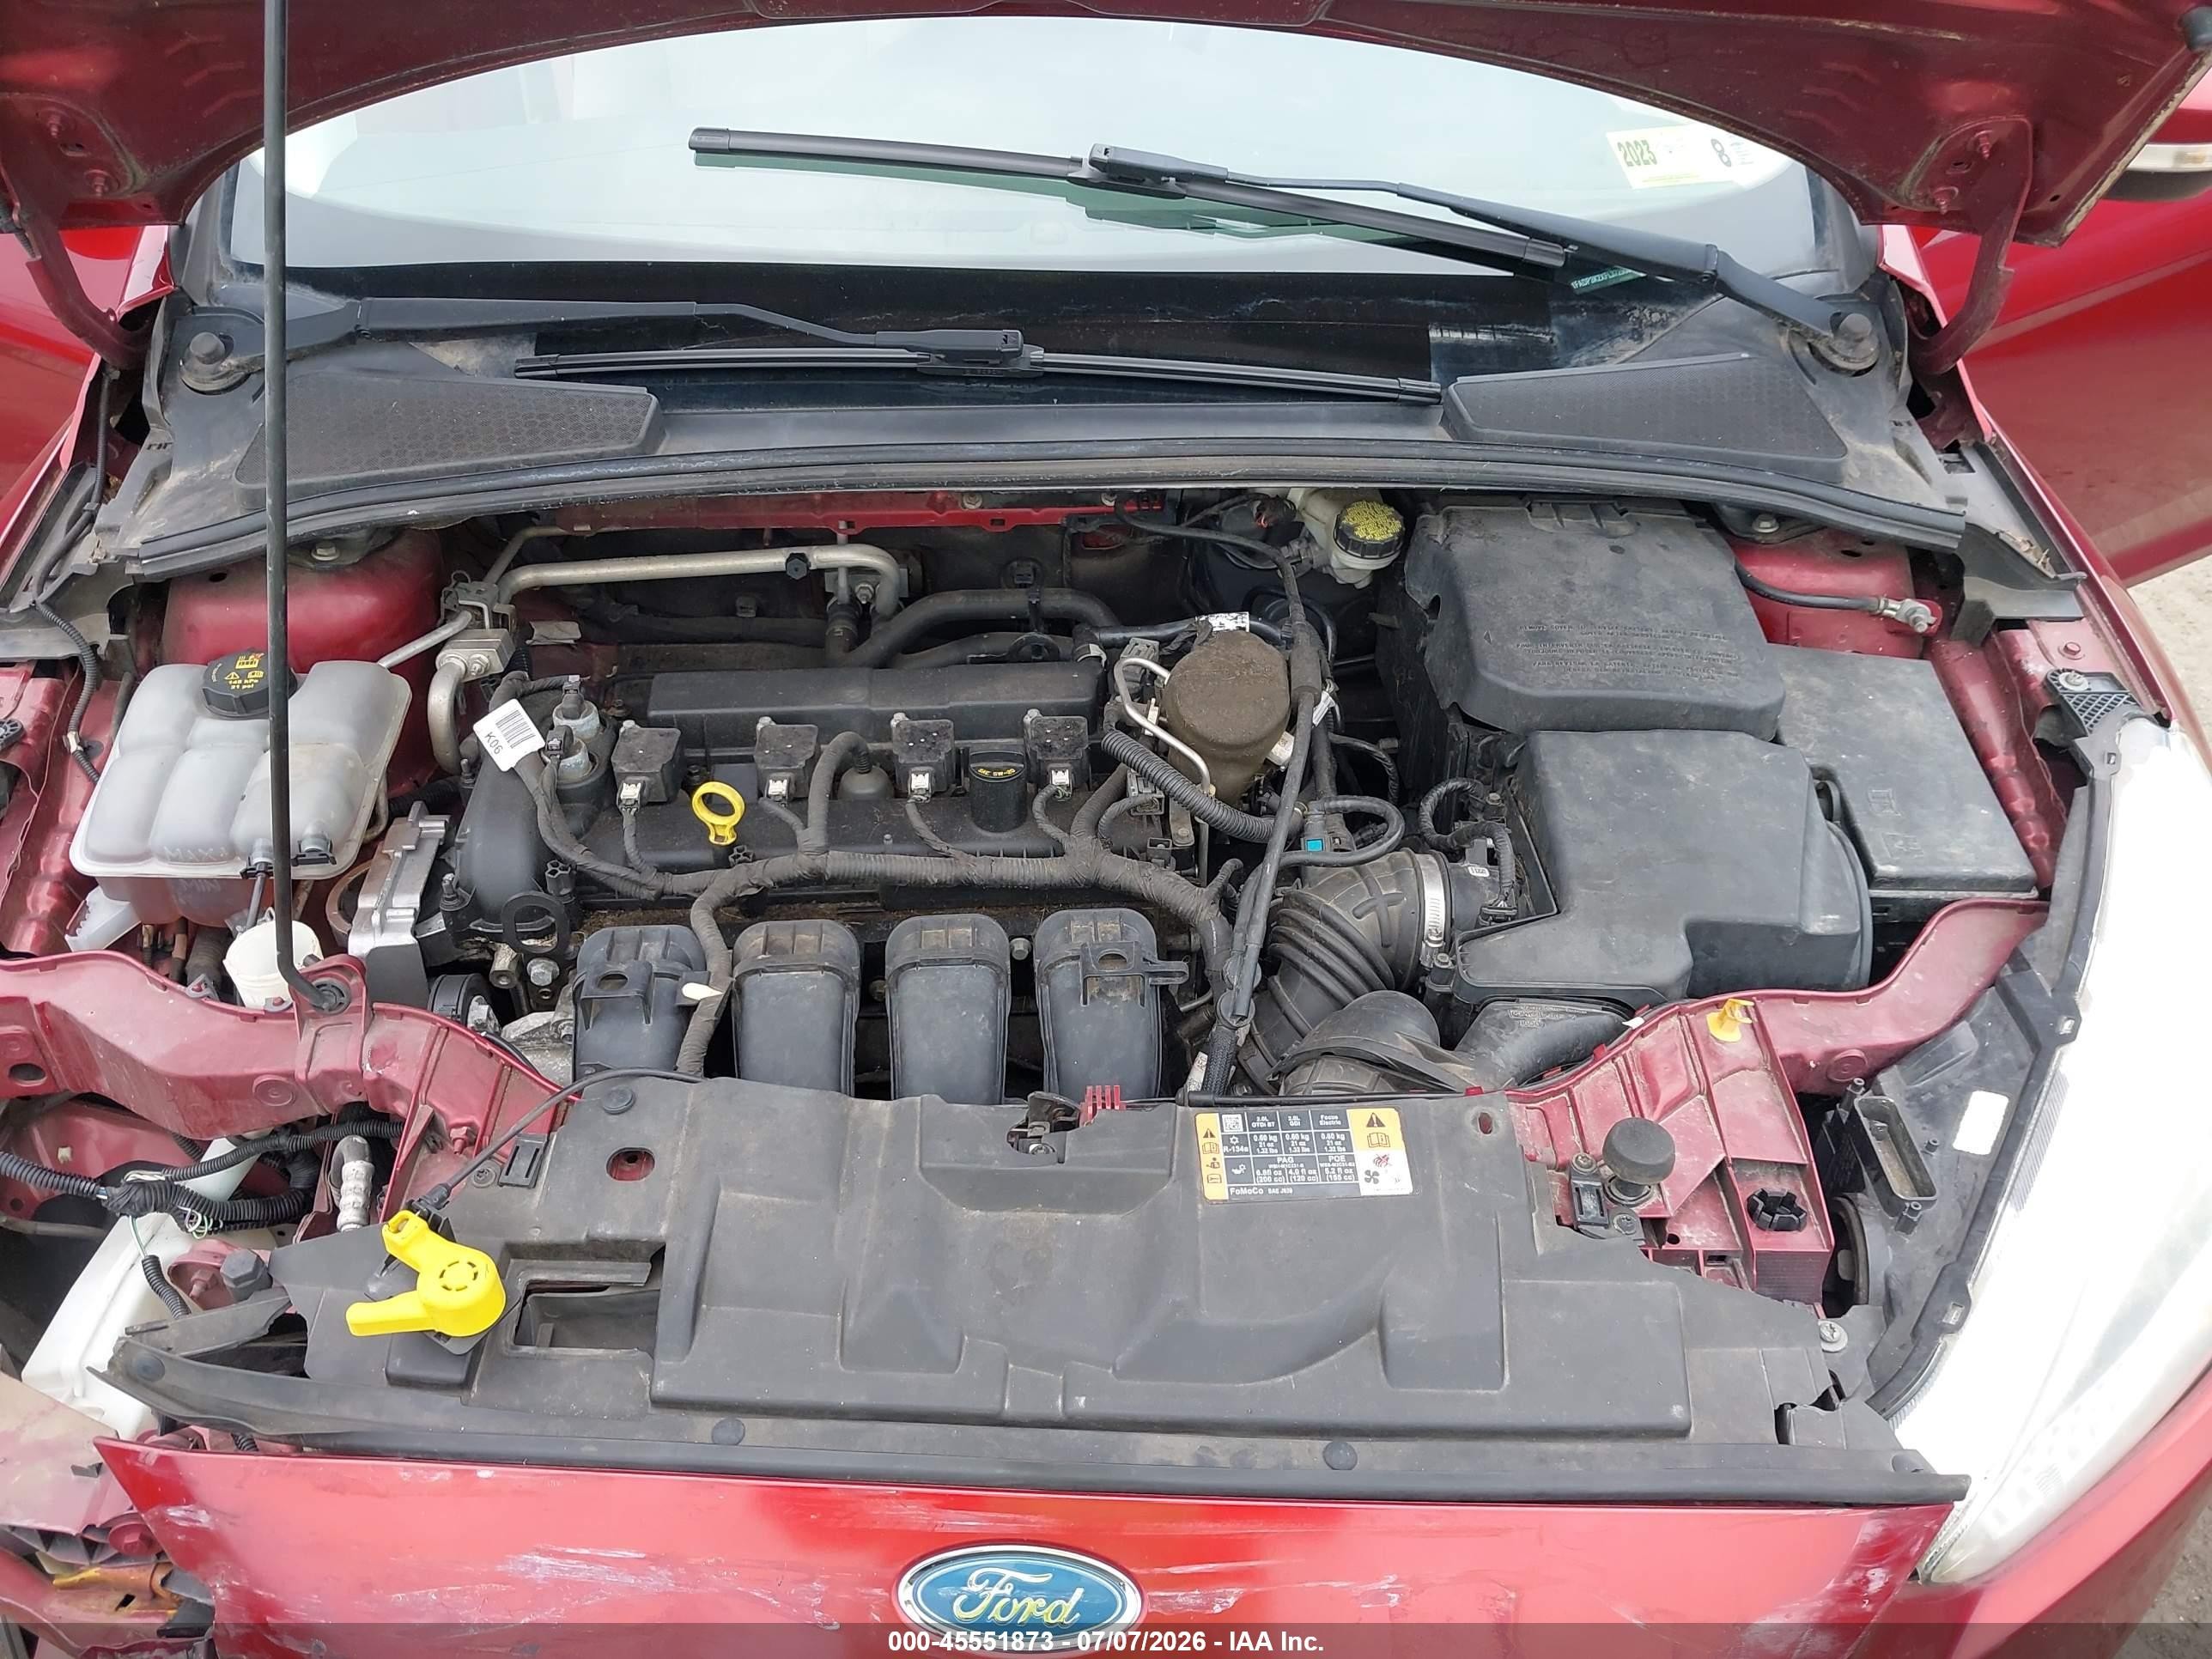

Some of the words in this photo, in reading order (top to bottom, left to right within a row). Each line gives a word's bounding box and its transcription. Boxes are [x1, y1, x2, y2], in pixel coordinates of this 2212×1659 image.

[1617, 139, 1657, 167] 2023
[1711, 139, 1732, 167] 8
[484, 731, 503, 754] K06
[1229, 1187, 1264, 1196] FoMoCo
[952, 1566, 1085, 1628] Ford
